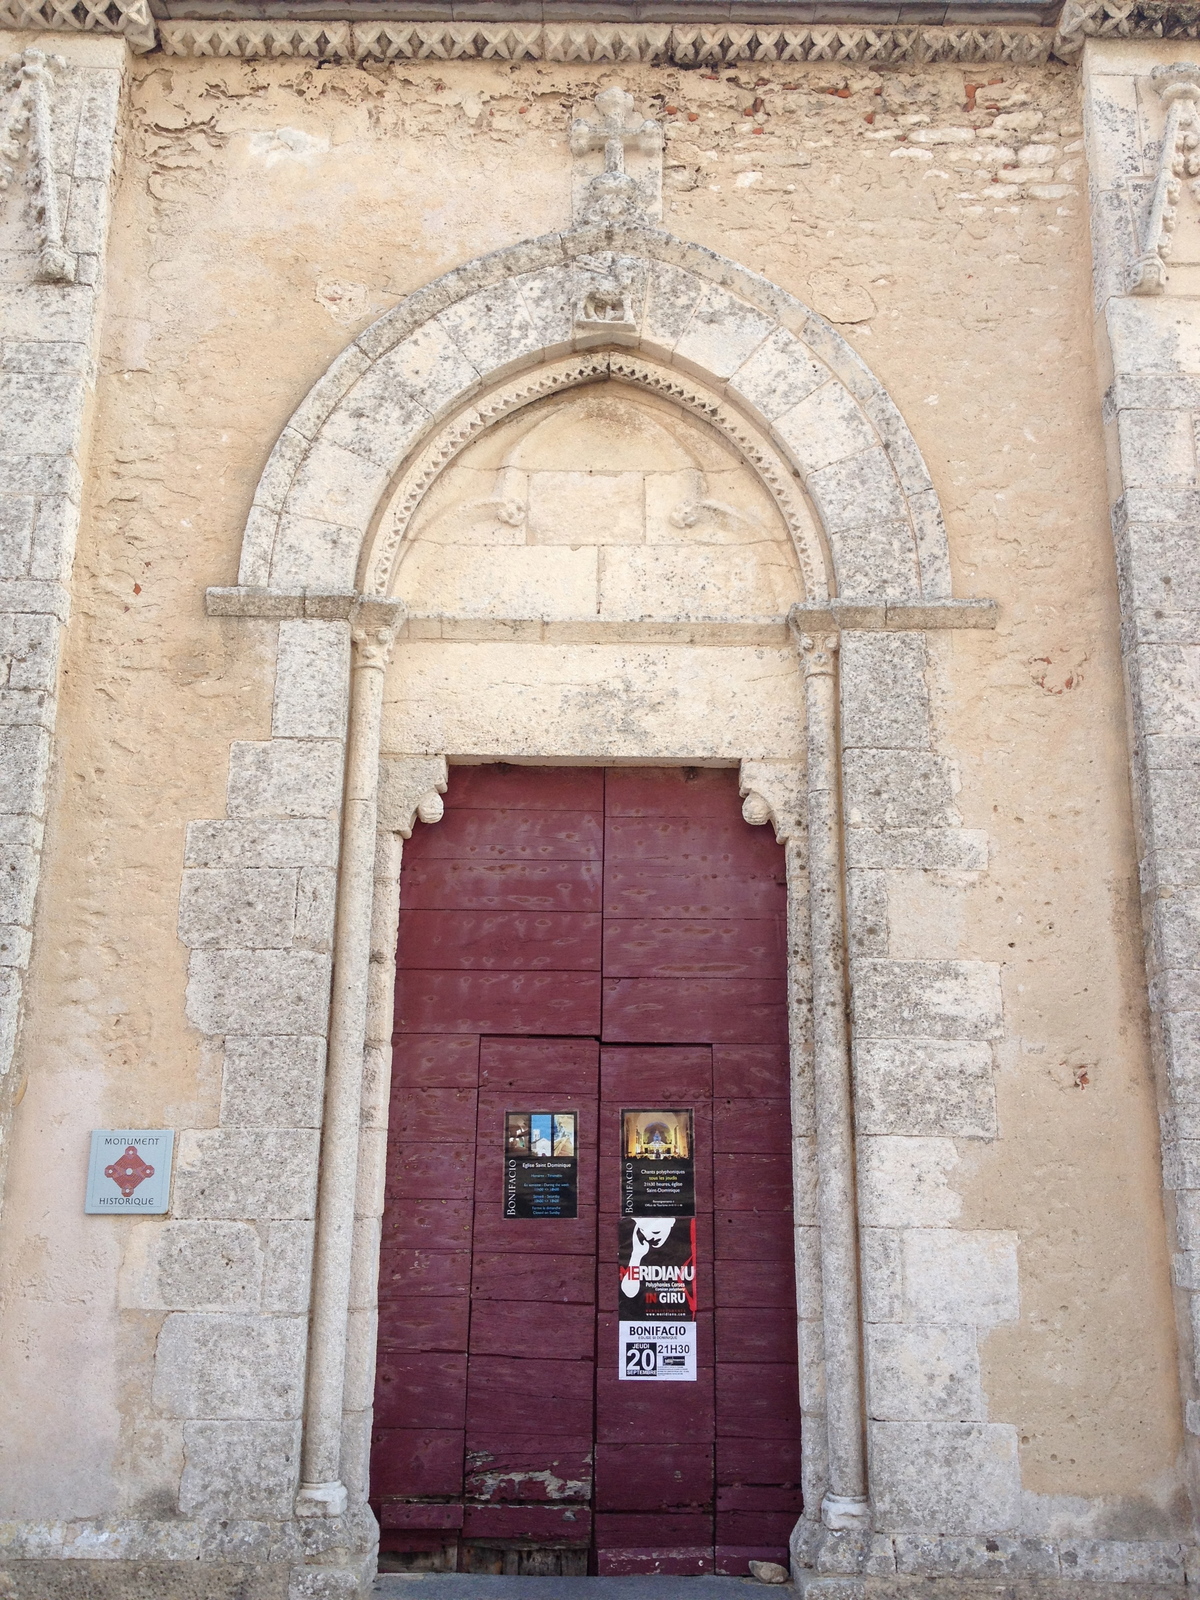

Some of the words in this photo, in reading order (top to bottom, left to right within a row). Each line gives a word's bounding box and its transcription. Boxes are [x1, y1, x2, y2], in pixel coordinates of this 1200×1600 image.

[104, 1138, 159, 1146] MONUMENT
[507, 1160, 516, 1215] BONIFACIO
[625, 1162, 634, 1213] BONIFACIO
[99, 1198, 154, 1206] HISTORIQUE
[619, 1266, 695, 1281] MERIDIANU
[645, 1293, 657, 1304] IN
[659, 1292, 686, 1304] GIRU
[629, 1326, 686, 1336] BONIFACIO
[658, 1345, 690, 1354] 21H30
[626, 1349, 655, 1371] 20
